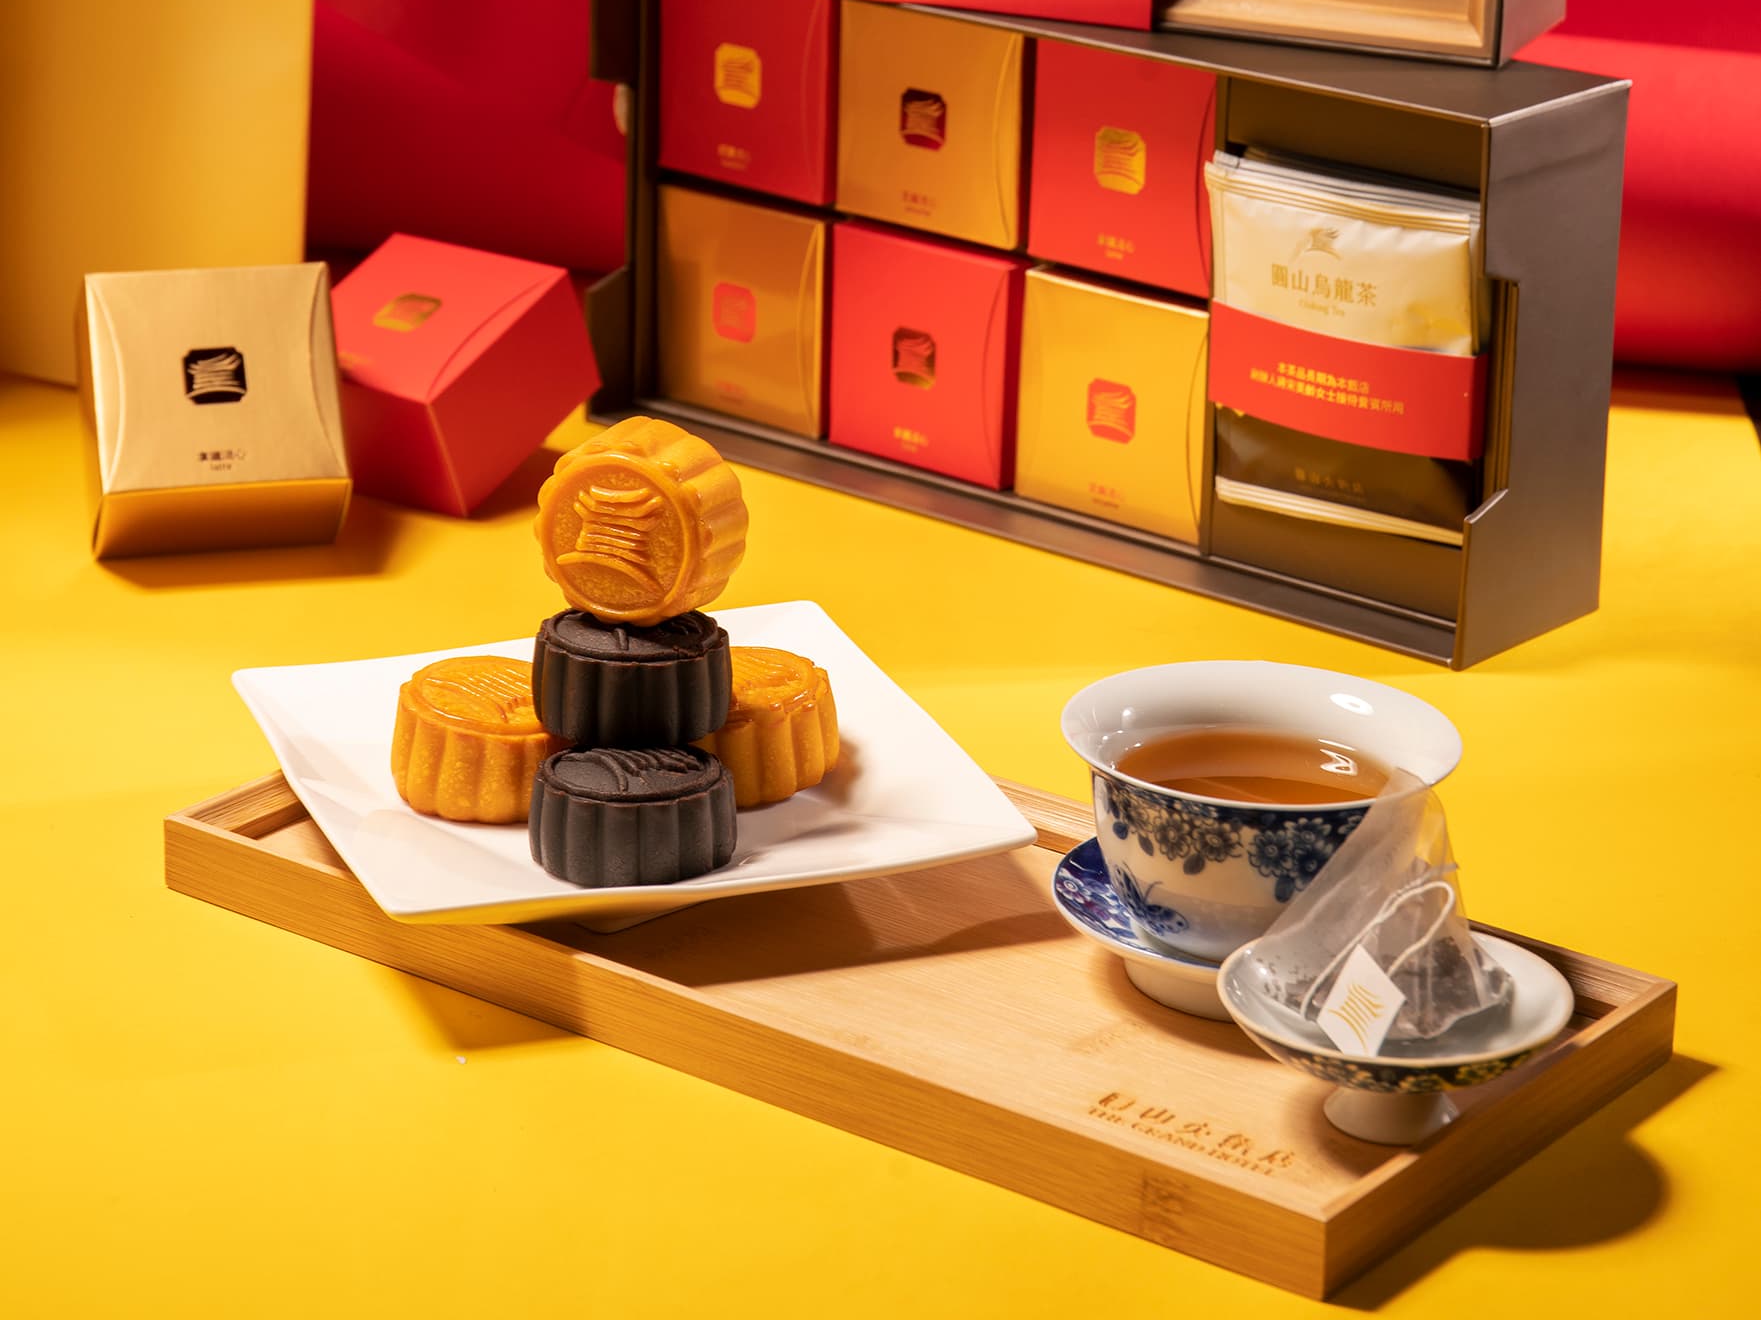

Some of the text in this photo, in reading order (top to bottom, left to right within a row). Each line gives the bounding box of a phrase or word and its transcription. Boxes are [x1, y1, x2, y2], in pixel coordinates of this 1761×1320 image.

[1271, 263, 1377, 307] 圓山烏龍茶
